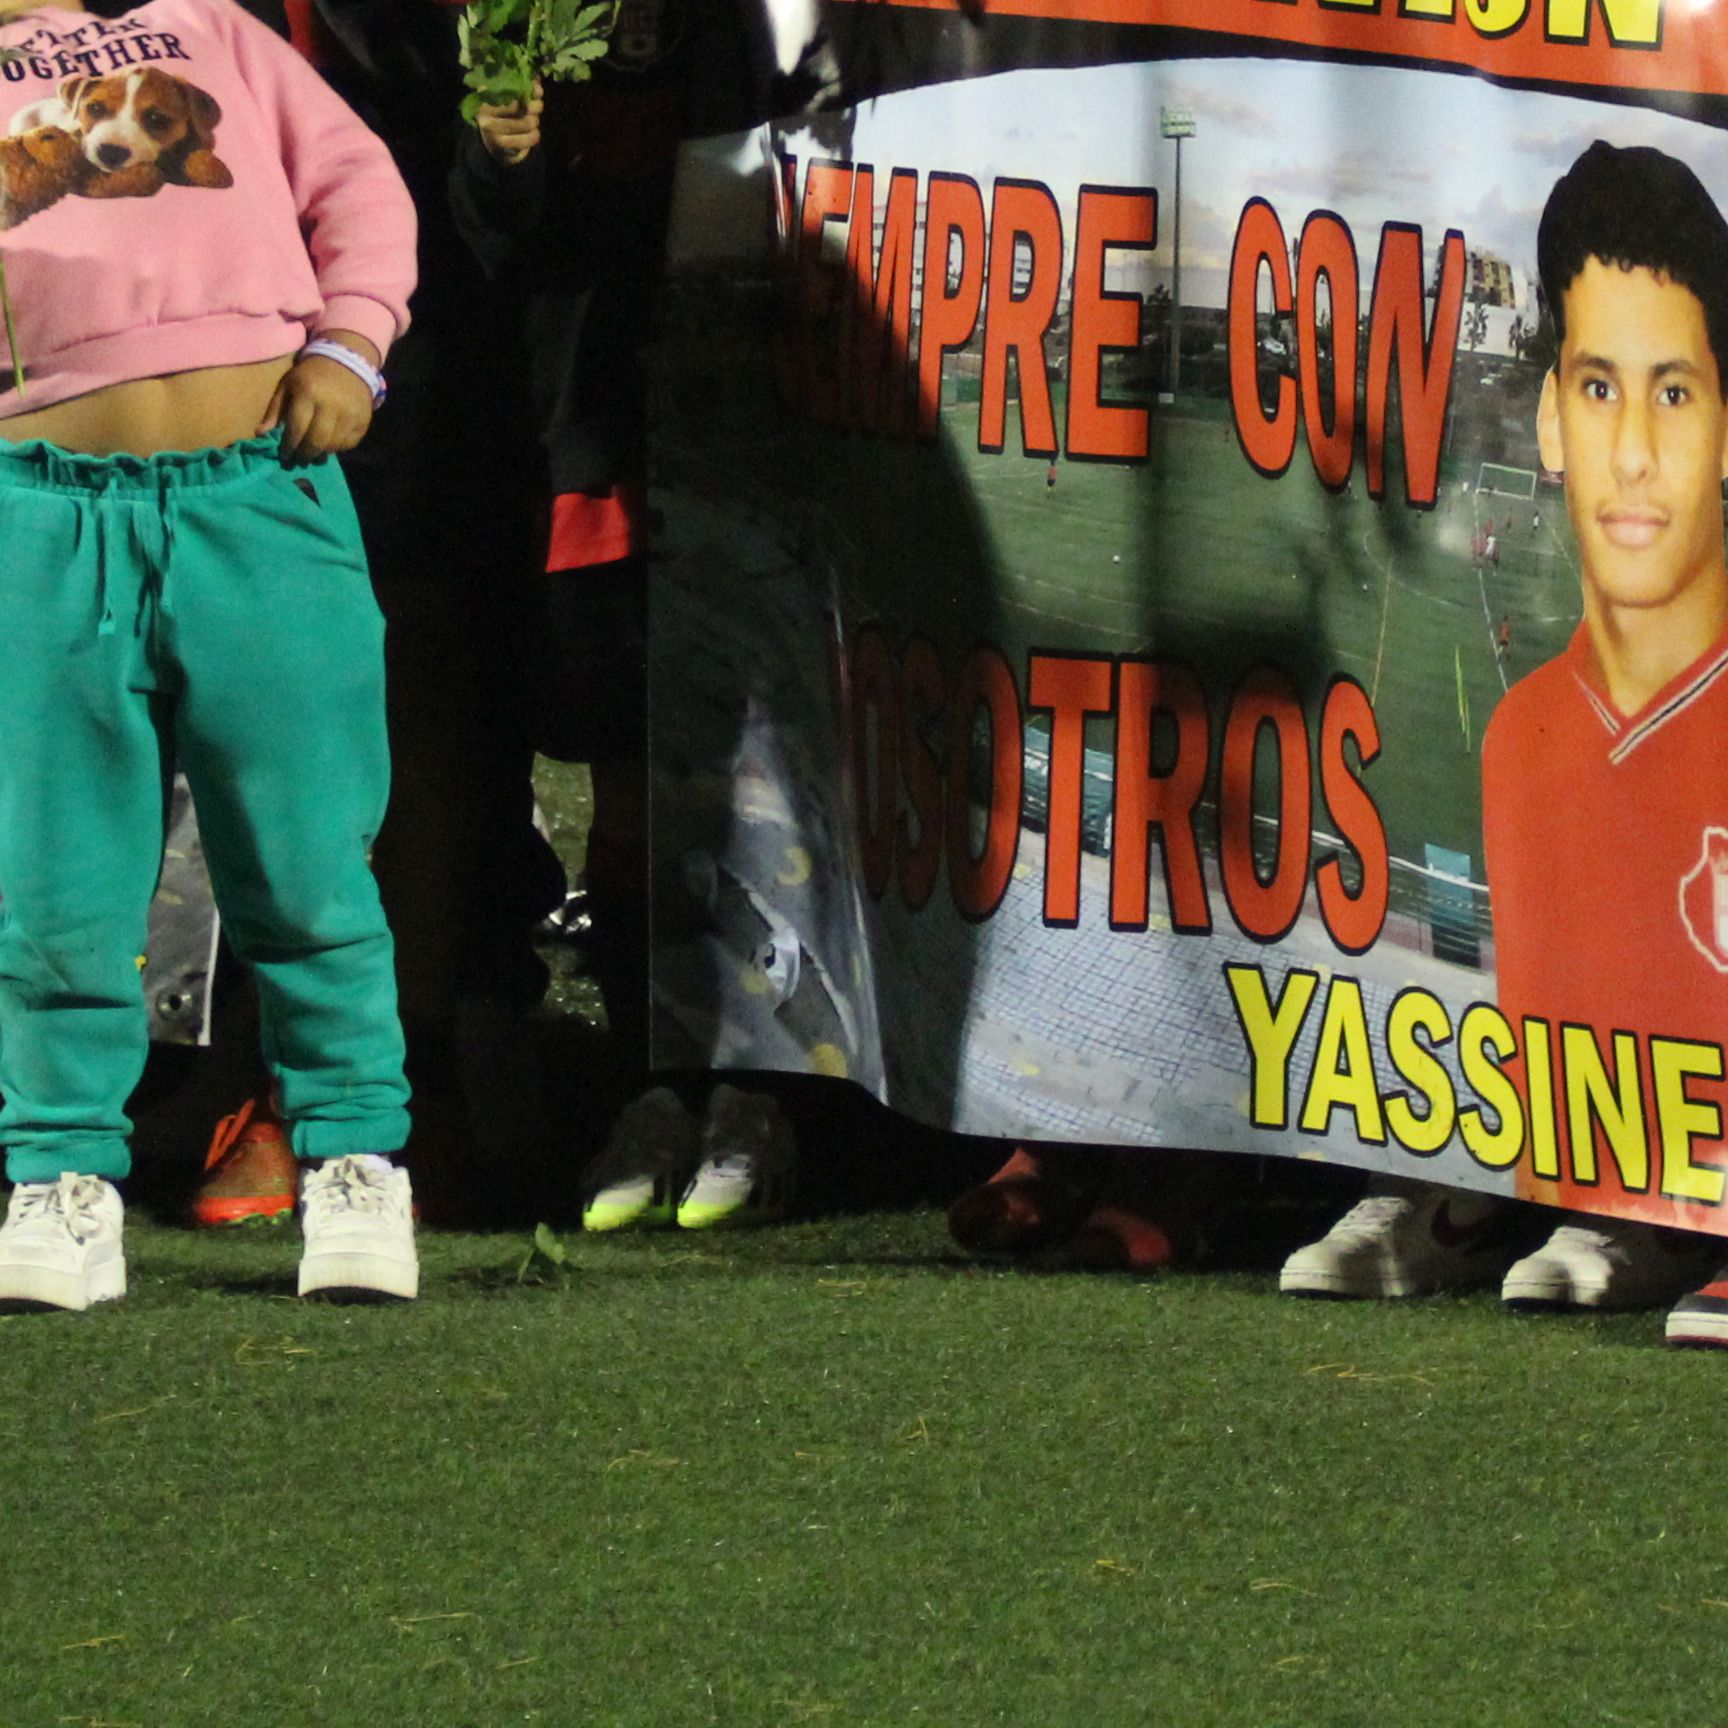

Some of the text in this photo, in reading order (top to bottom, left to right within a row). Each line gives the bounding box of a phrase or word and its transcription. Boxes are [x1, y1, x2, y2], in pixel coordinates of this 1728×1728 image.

[1228, 196, 1467, 512] CON
[827, 621, 1390, 957] OSOTROS
[1223, 963, 1728, 1207] YASSINE
